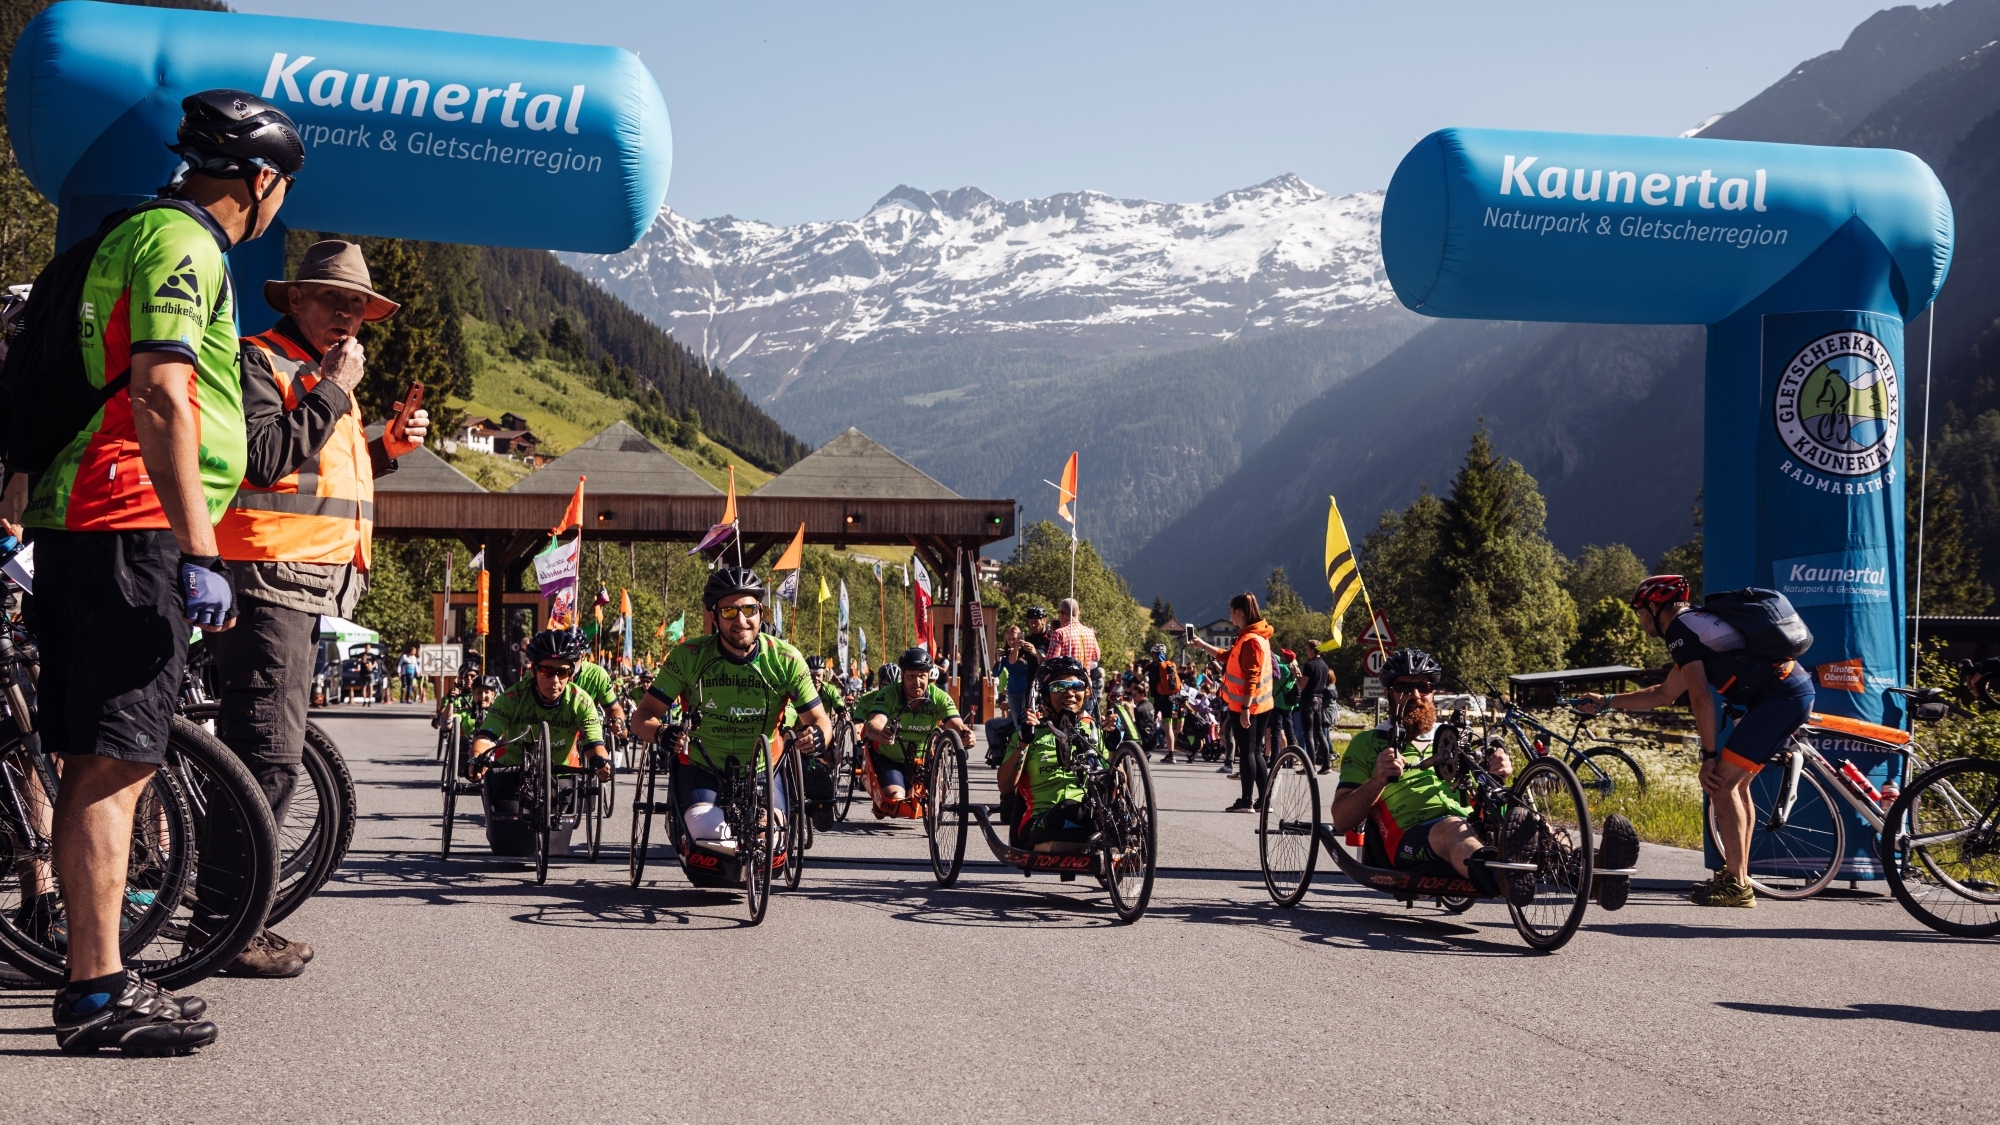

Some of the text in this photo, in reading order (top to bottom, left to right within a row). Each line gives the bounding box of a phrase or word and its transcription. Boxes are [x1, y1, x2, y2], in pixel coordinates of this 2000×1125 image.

[260, 52, 586, 135] Kaunertal
[298, 122, 602, 174] rpark & Gletscherregion
[1500, 154, 1768, 212] Kaunertal
[1483, 206, 1788, 248] Naturpark & Gletscherregion
[1779, 335, 1897, 428] GLETSCHERKAISER XXL
[1779, 460, 1897, 495] RADMARATHON
[1789, 564, 1886, 585] Kaunertal
[1783, 585, 1825, 594] Naturpark
[1827, 585, 1834, 593] &
[970, 604, 982, 627] STOP
[1823, 673, 1860, 682] Oberland
[1829, 665, 1856, 674] Tiroler
[711, 725, 755, 734] Wellspect
[39, 771, 58, 805] SUNTO
[688, 853, 718, 867] END
[1034, 854, 1061, 867] TOP
[1059, 855, 1091, 868] END
[1416, 876, 1447, 890] TOP
